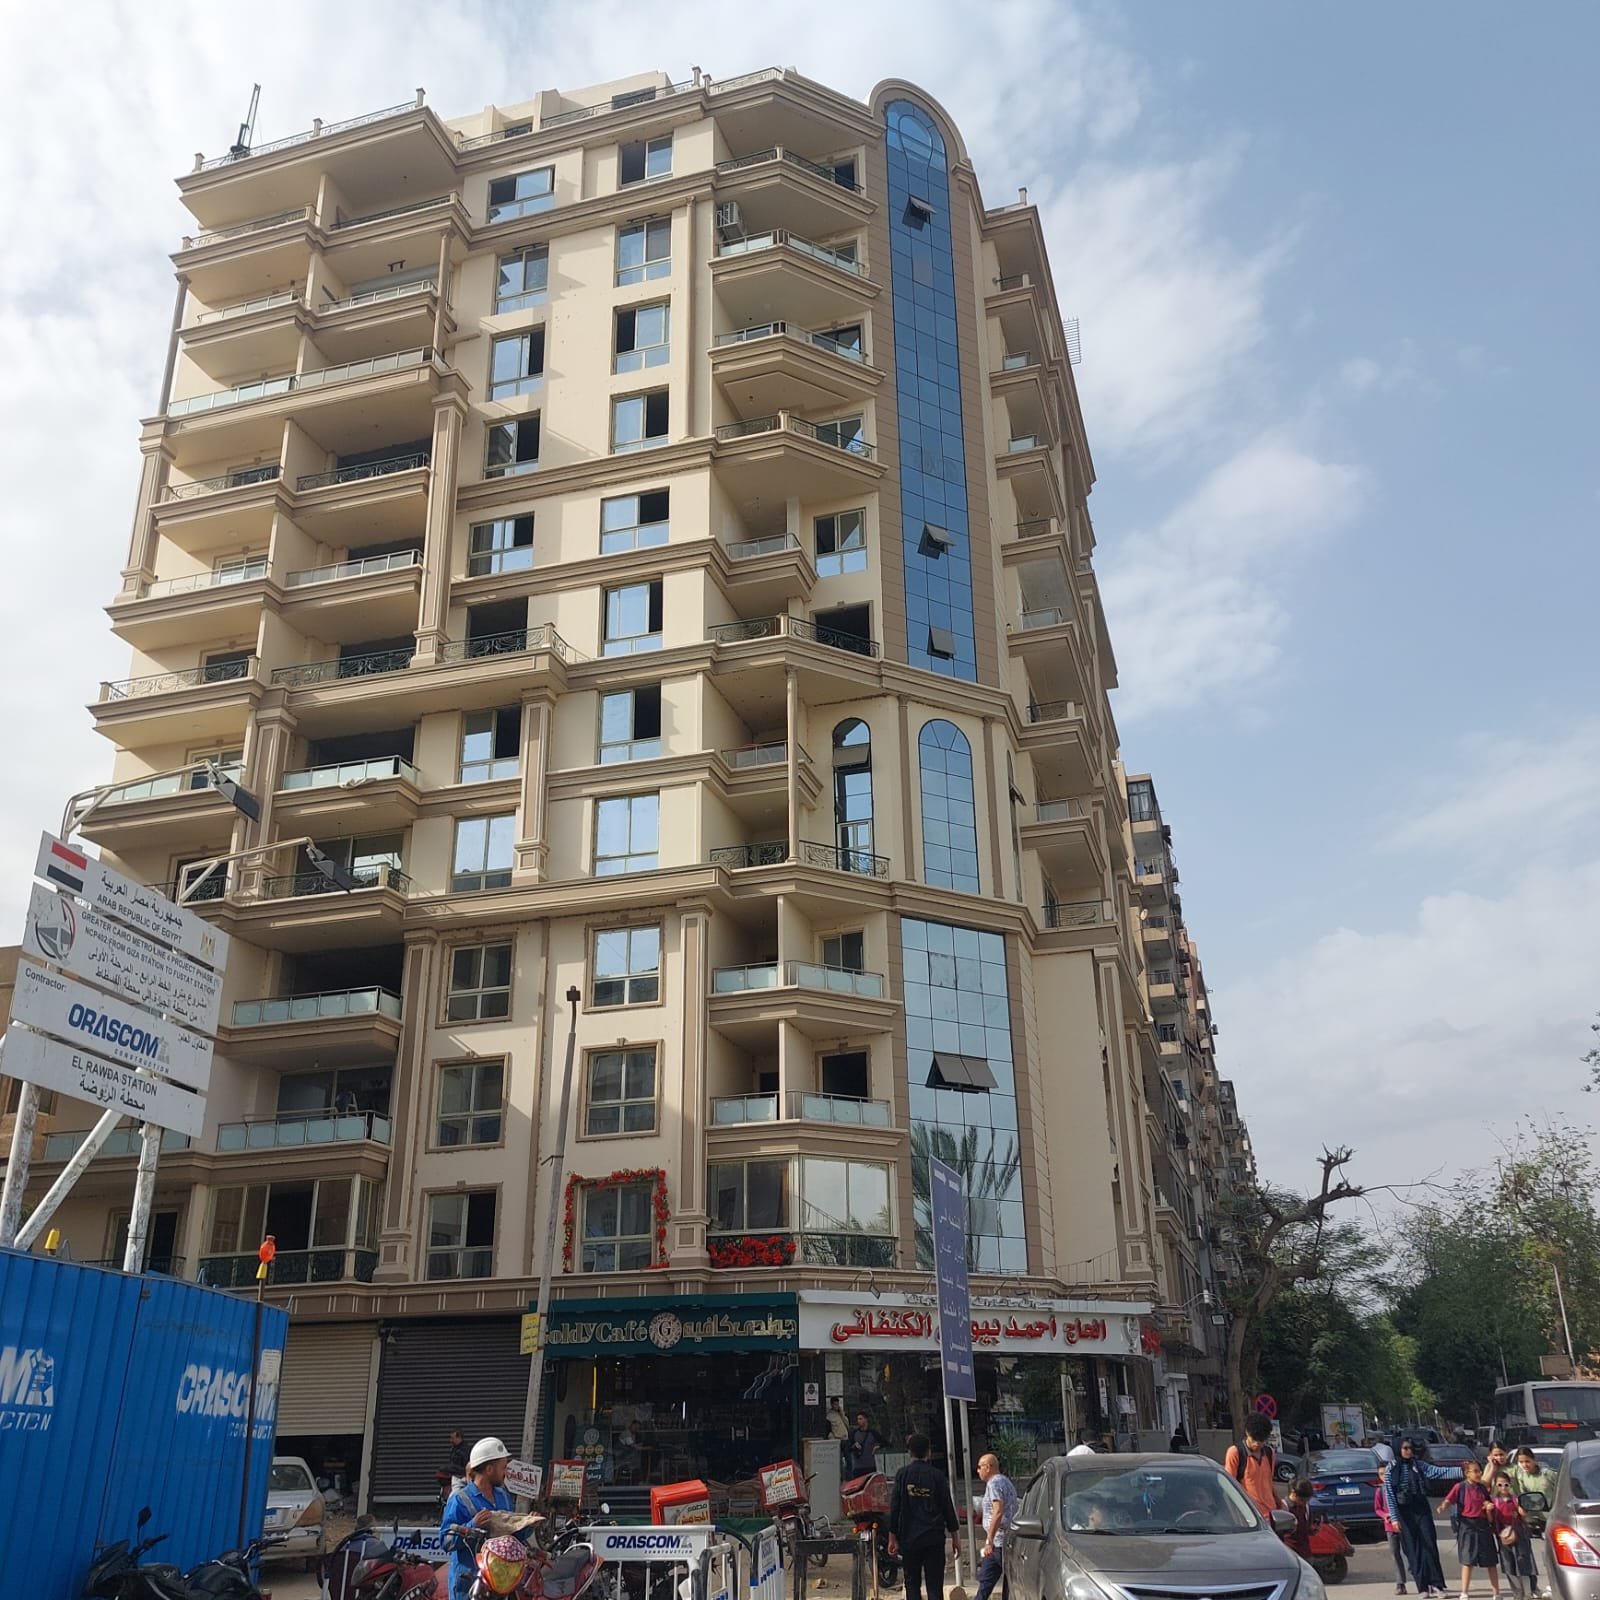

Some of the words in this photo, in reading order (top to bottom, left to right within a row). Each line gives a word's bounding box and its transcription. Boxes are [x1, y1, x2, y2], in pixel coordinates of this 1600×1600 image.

[101, 870, 128, 897] العربية
[130, 888, 149, 909] مصر
[97, 894, 117, 910] ARAB
[118, 905, 151, 929] REPUBLIC
[152, 922, 161, 932] OF
[162, 927, 182, 944] EGYPT
[152, 898, 183, 928] جمهورية
[82, 912, 112, 932] GREATER
[112, 926, 132, 941] CAIRO
[132, 936, 153, 953] METRO
[153, 945, 166, 960] LINE
[171, 957, 197, 975] PROJECT
[196, 967, 214, 984] PHASE
[25, 967, 67, 992] Contractor:
[127, 947, 140, 960] GIZA
[141, 952, 164, 972] STATION
[165, 965, 173, 976] TO
[173, 969, 194, 987] FUSTAT
[194, 980, 216, 996] STATION
[68, 1003, 159, 1058] ORASCOM
[114, 1048, 170, 1074] CONSTRUCTION
[71, 1055, 83, 1070] EL
[85, 1060, 119, 1084] RAWDA
[122, 1072, 157, 1096] STATION
[79, 1074, 117, 1102] الروضة
[120, 1091, 146, 1111] محطة
[1063, 1316, 1108, 1346] الحاج
[393, 1536, 441, 1550] ORASC
[606, 1535, 680, 1549] ORASCOM
